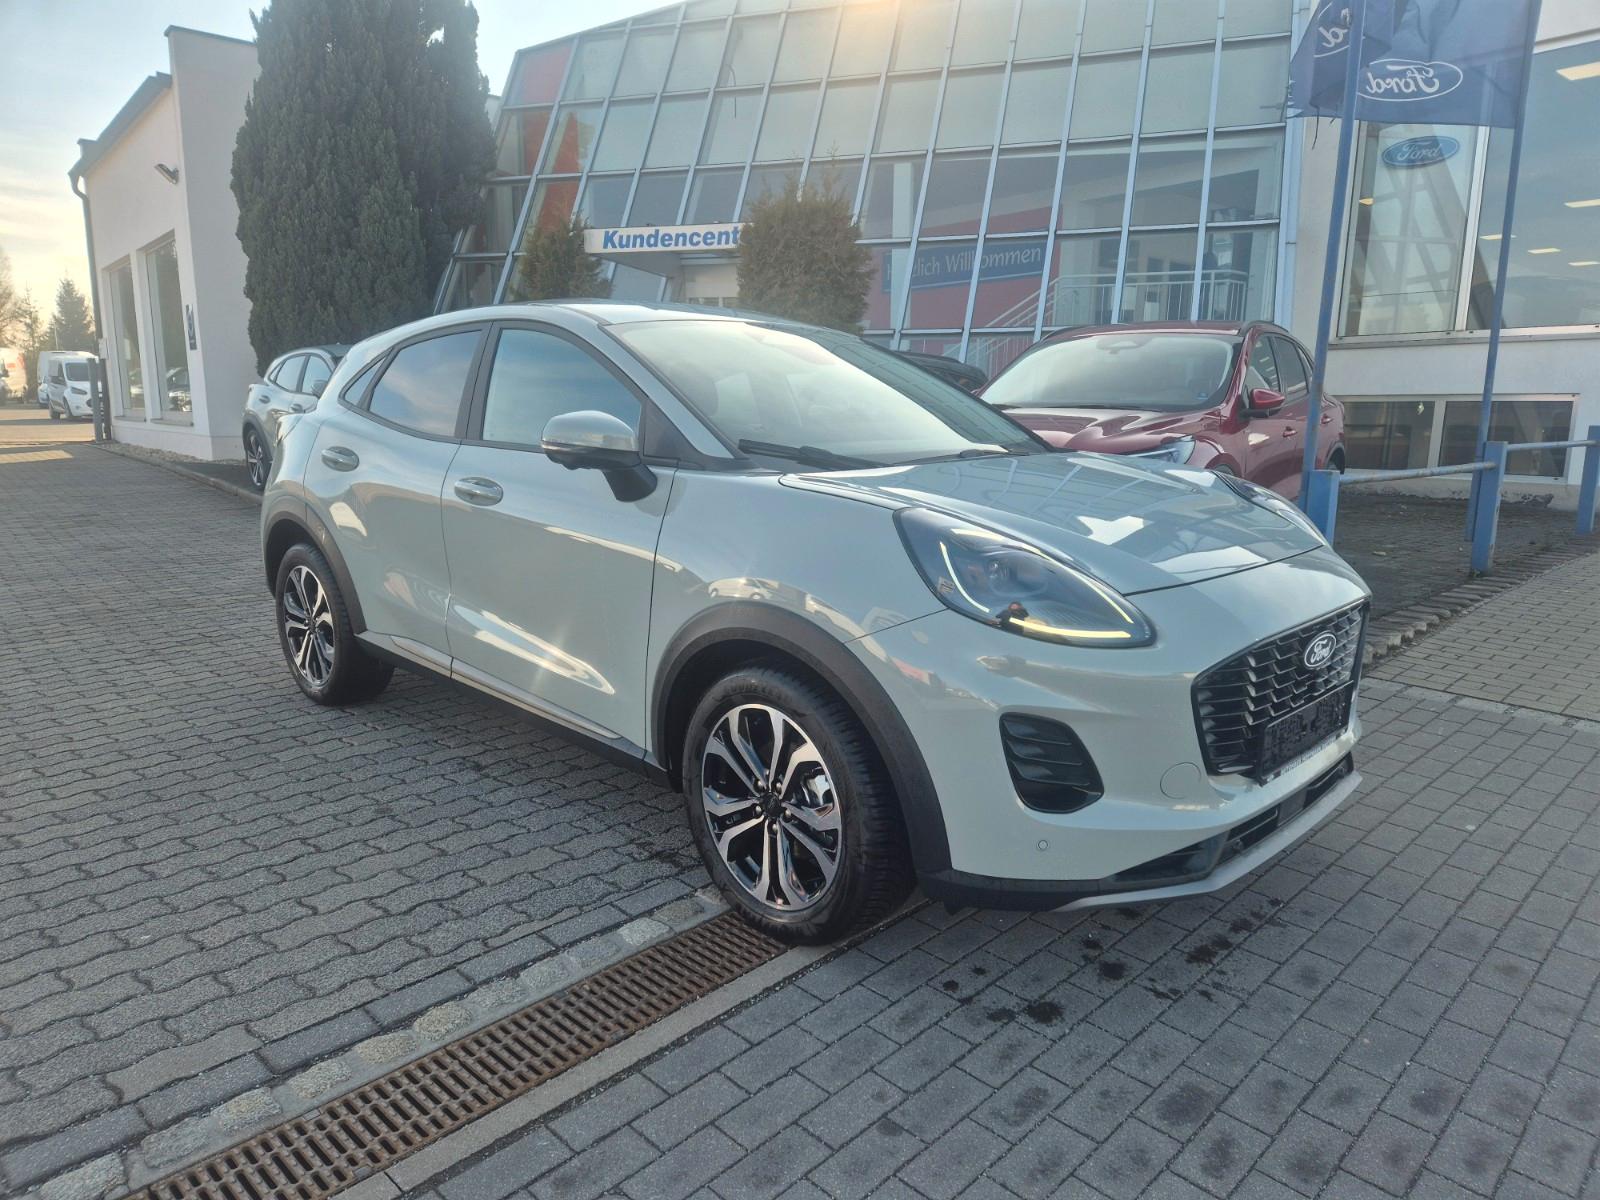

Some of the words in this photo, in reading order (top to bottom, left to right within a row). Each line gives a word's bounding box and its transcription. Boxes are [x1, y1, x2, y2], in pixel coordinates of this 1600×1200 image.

[1397, 140, 1441, 161] Ford
[603, 226, 741, 250] Kundencent
[1310, 638, 1332, 664] Ford
